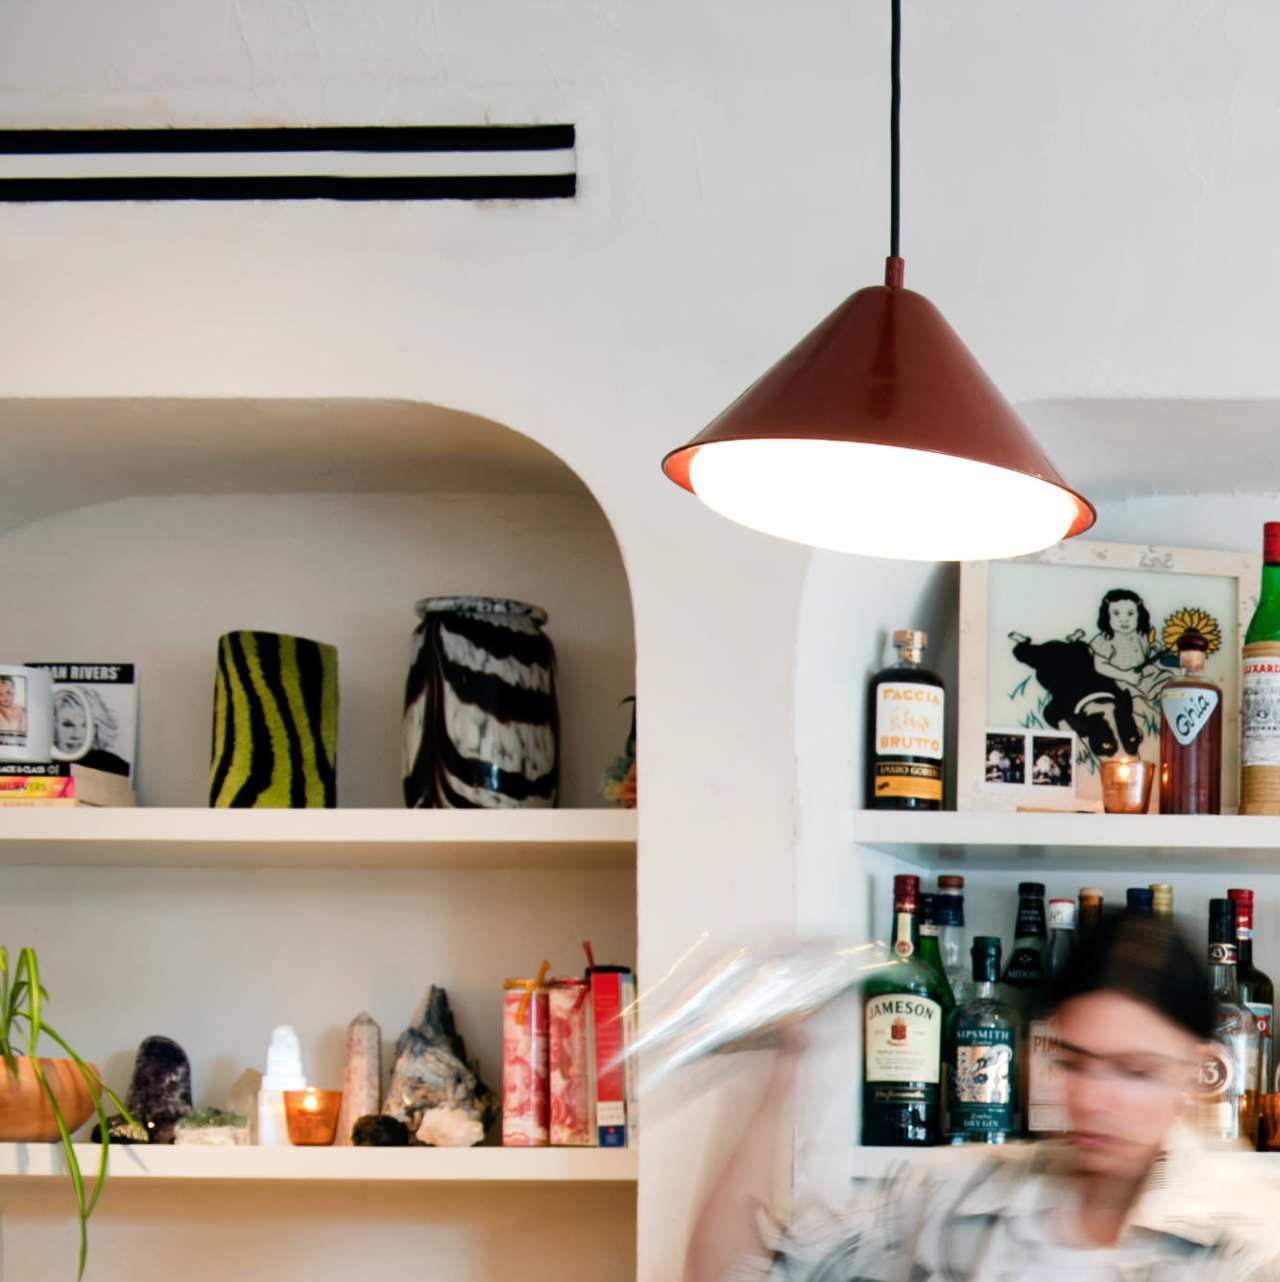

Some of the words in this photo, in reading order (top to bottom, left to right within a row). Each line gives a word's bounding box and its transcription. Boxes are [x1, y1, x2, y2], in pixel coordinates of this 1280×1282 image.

[70, 665, 118, 681] RIVERS
[1175, 693, 1210, 737] Ghia
[879, 735, 940, 753] BRUTTO
[869, 1000, 934, 1021] JAMESON
